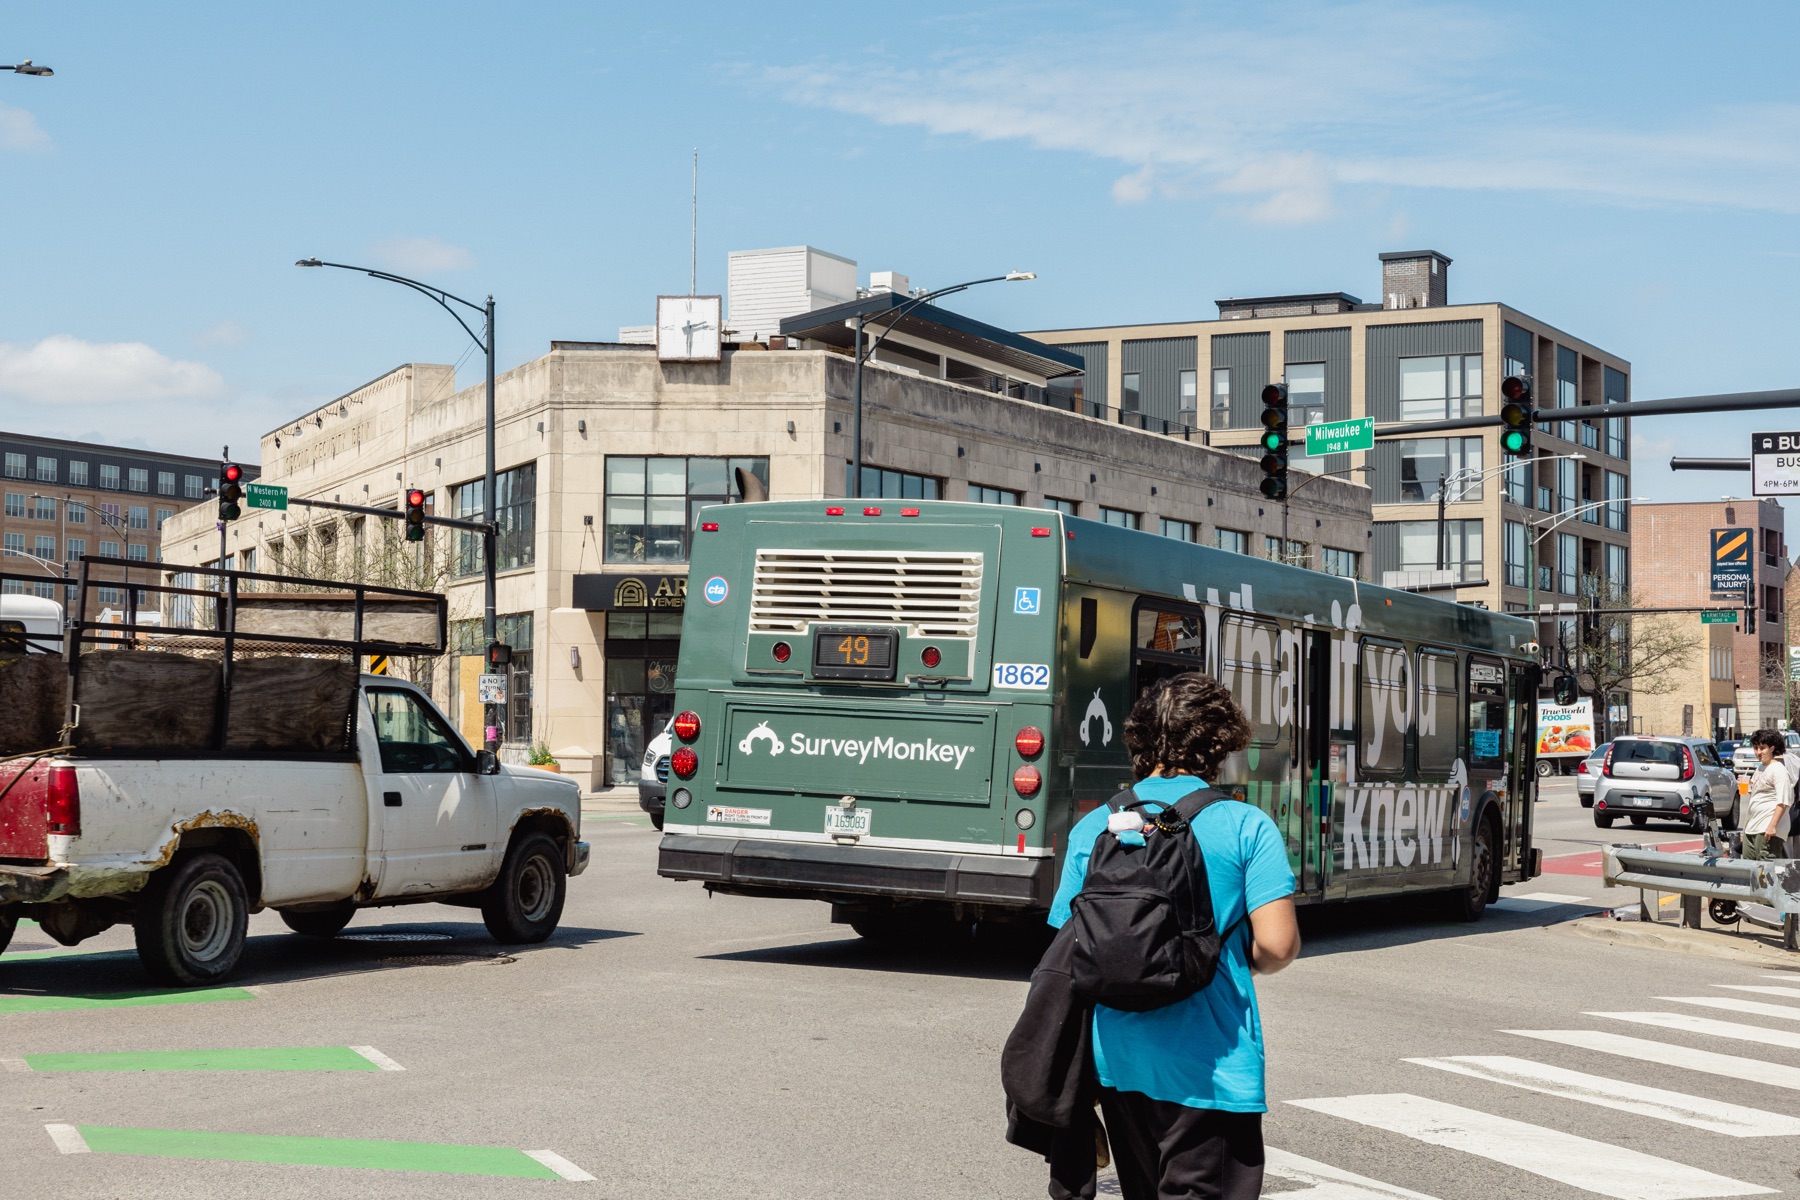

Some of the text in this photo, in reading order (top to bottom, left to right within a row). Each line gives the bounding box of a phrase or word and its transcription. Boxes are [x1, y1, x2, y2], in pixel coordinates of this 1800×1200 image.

[1307, 420, 1373, 441] N Milwaukee Av
[1326, 441, 1349, 452] 1948 N
[1763, 480, 1799, 488] 4PM-6PM
[247, 485, 287, 496] N Western Av
[259, 499, 271, 508] 2400
[708, 585, 725, 595] cta
[838, 636, 869, 664] 49
[995, 665, 1048, 685] 1862
[1330, 599, 1362, 730] if
[1361, 642, 1437, 768] you
[1541, 706, 1586, 716] True World
[1541, 714, 1572, 722] FOODS
[834, 815, 866, 829] 169083
